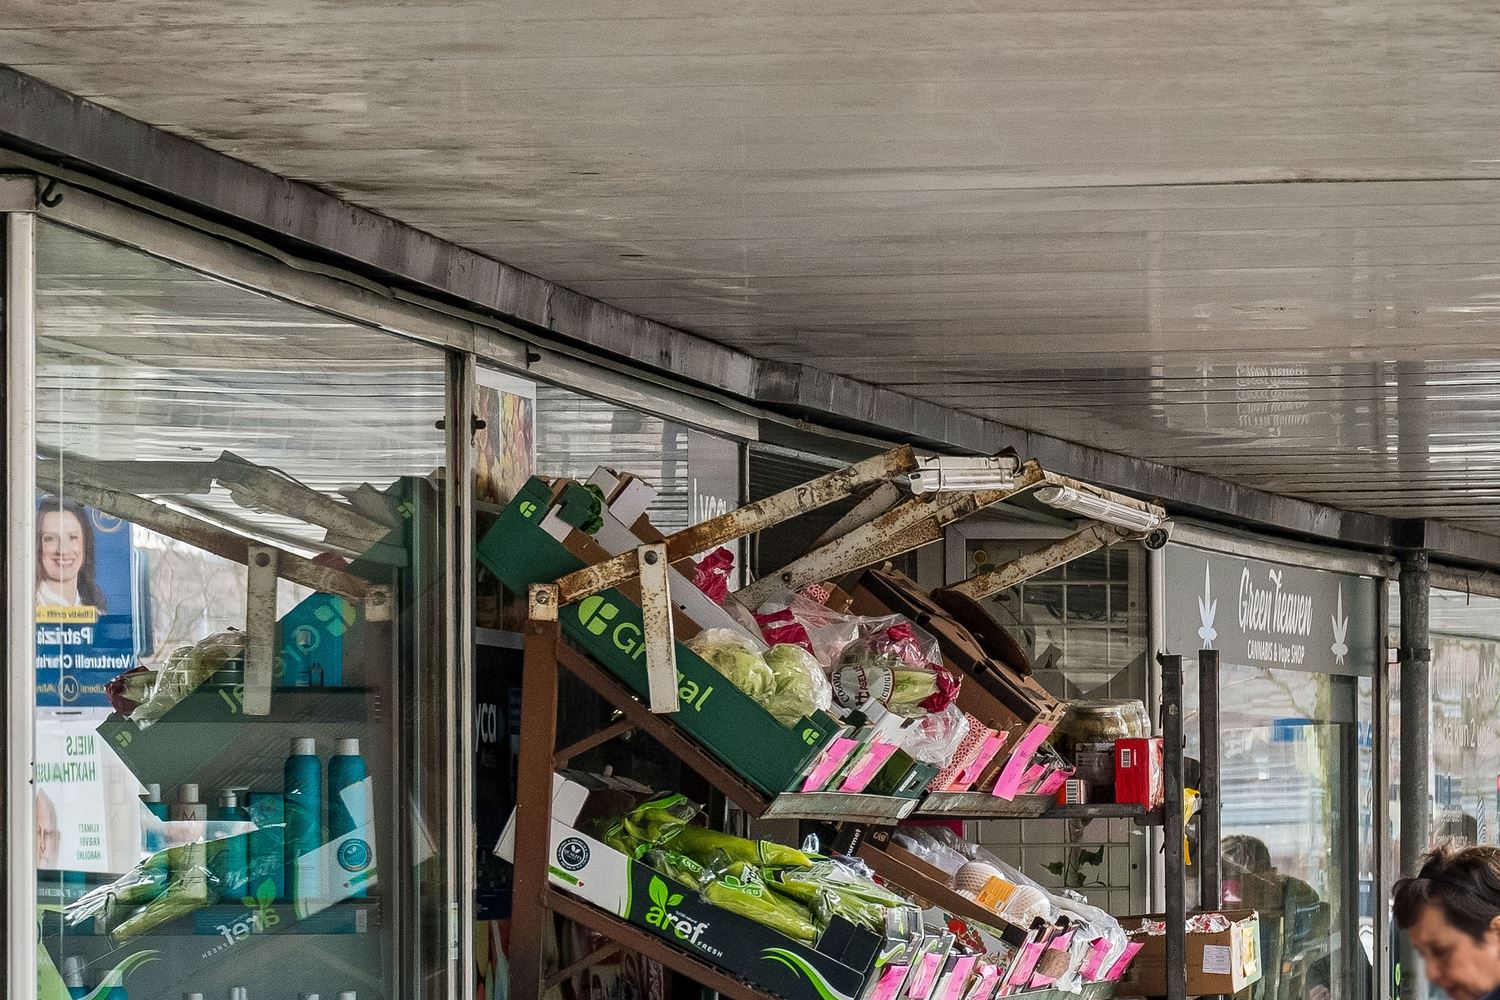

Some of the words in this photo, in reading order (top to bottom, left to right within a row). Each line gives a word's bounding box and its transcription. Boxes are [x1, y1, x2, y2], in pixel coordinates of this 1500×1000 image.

[1239, 566, 1272, 634] Green
[1247, 639, 1273, 662] CANNABIS
[645, 906, 711, 945] aref
[697, 941, 723, 958] FRESH
